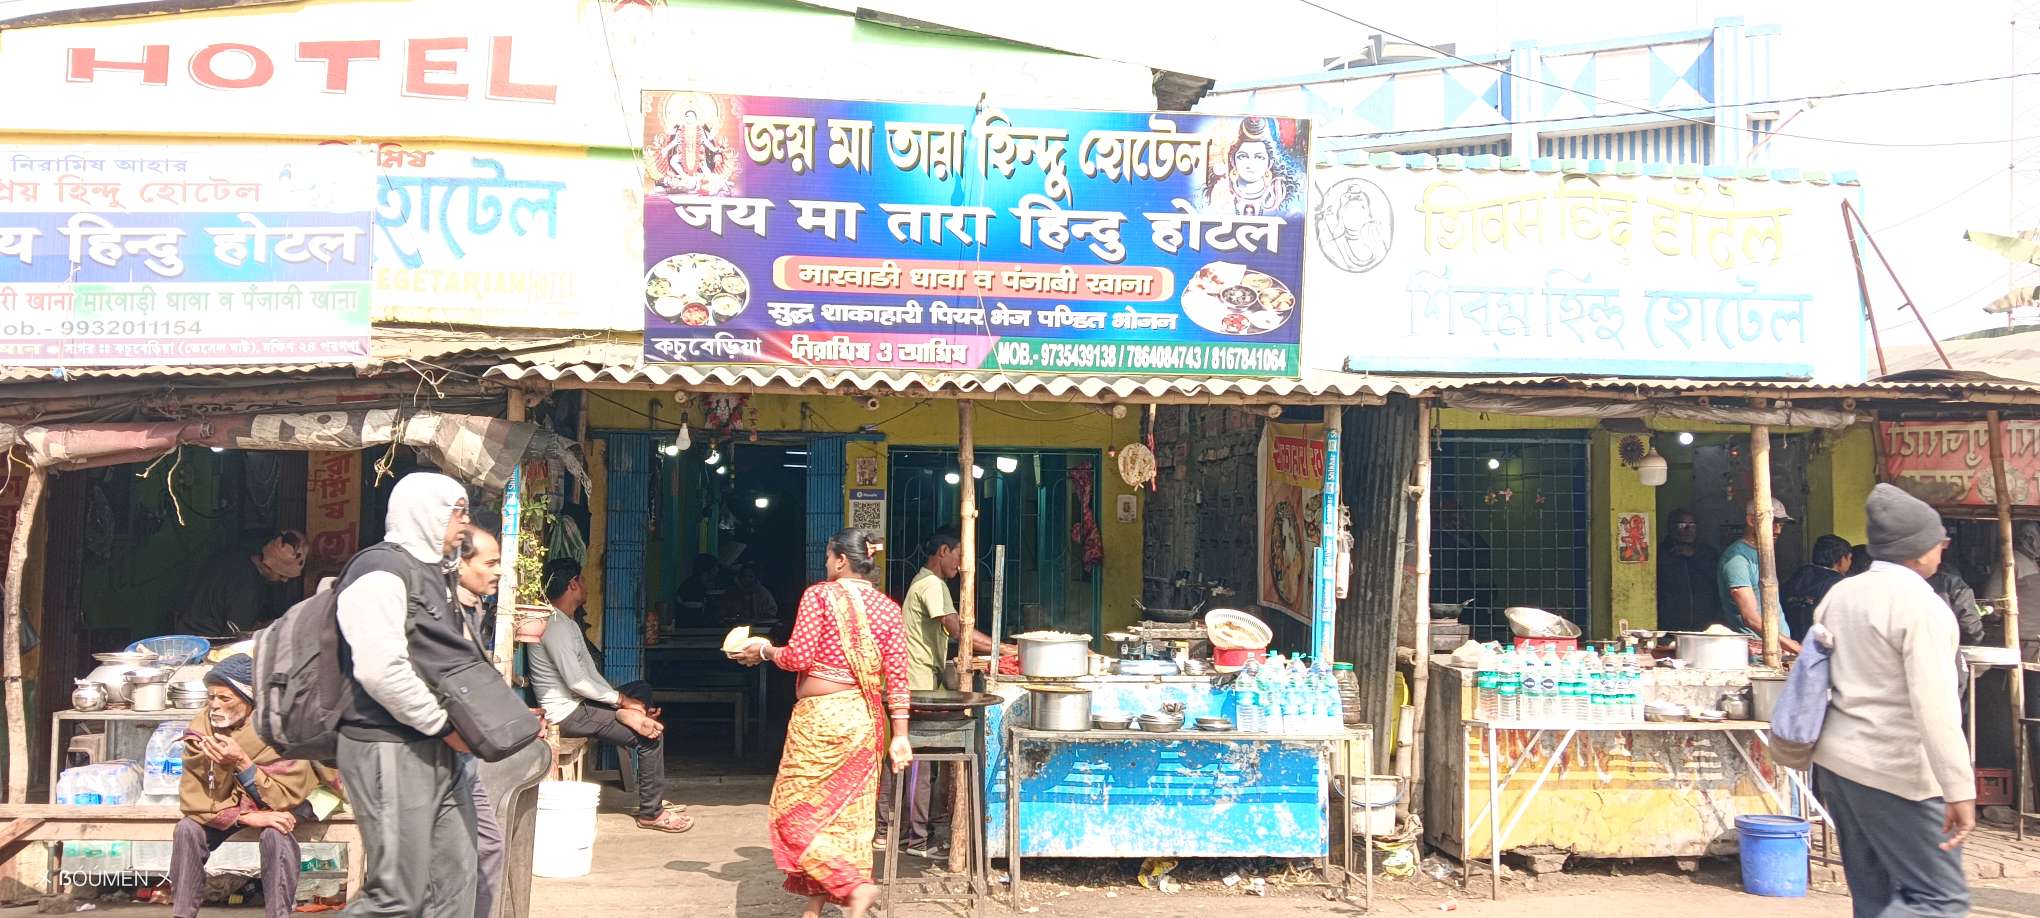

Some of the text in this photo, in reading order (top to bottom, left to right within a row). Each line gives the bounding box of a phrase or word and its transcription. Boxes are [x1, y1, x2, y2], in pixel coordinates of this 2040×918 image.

[65, 35, 558, 105] HOTEL
[114, 157, 188, 174] আহার
[743, 107, 1212, 208] জয় মা তারা হিন্দু হোটেল
[54, 174, 126, 209] হিন্দু
[140, 175, 263, 205] হোটেল
[668, 193, 1288, 264] जय मा तारा हिन्दु होटल
[57, 213, 187, 278] हिन्दु
[204, 213, 366, 266] होटल
[377, 266, 526, 294] EGETARIAN
[973, 270, 995, 291] व
[1086, 273, 1154, 296] खाना
[218, 291, 235, 312] व
[310, 290, 359, 311] खाना
[929, 301, 986, 326] पियर
[1112, 305, 1179, 330] भोजन
[1642, 275, 1815, 350] হোটেল
[0, 319, 202, 336] ob.- 9932011154
[650, 331, 762, 361] কচুবেড়িয়া
[876, 342, 894, 363] ও
[1041, 343, 1117, 368] 9735439138
[1126, 345, 1202, 369] 7864084743
[1211, 346, 1287, 371] 8167841064
